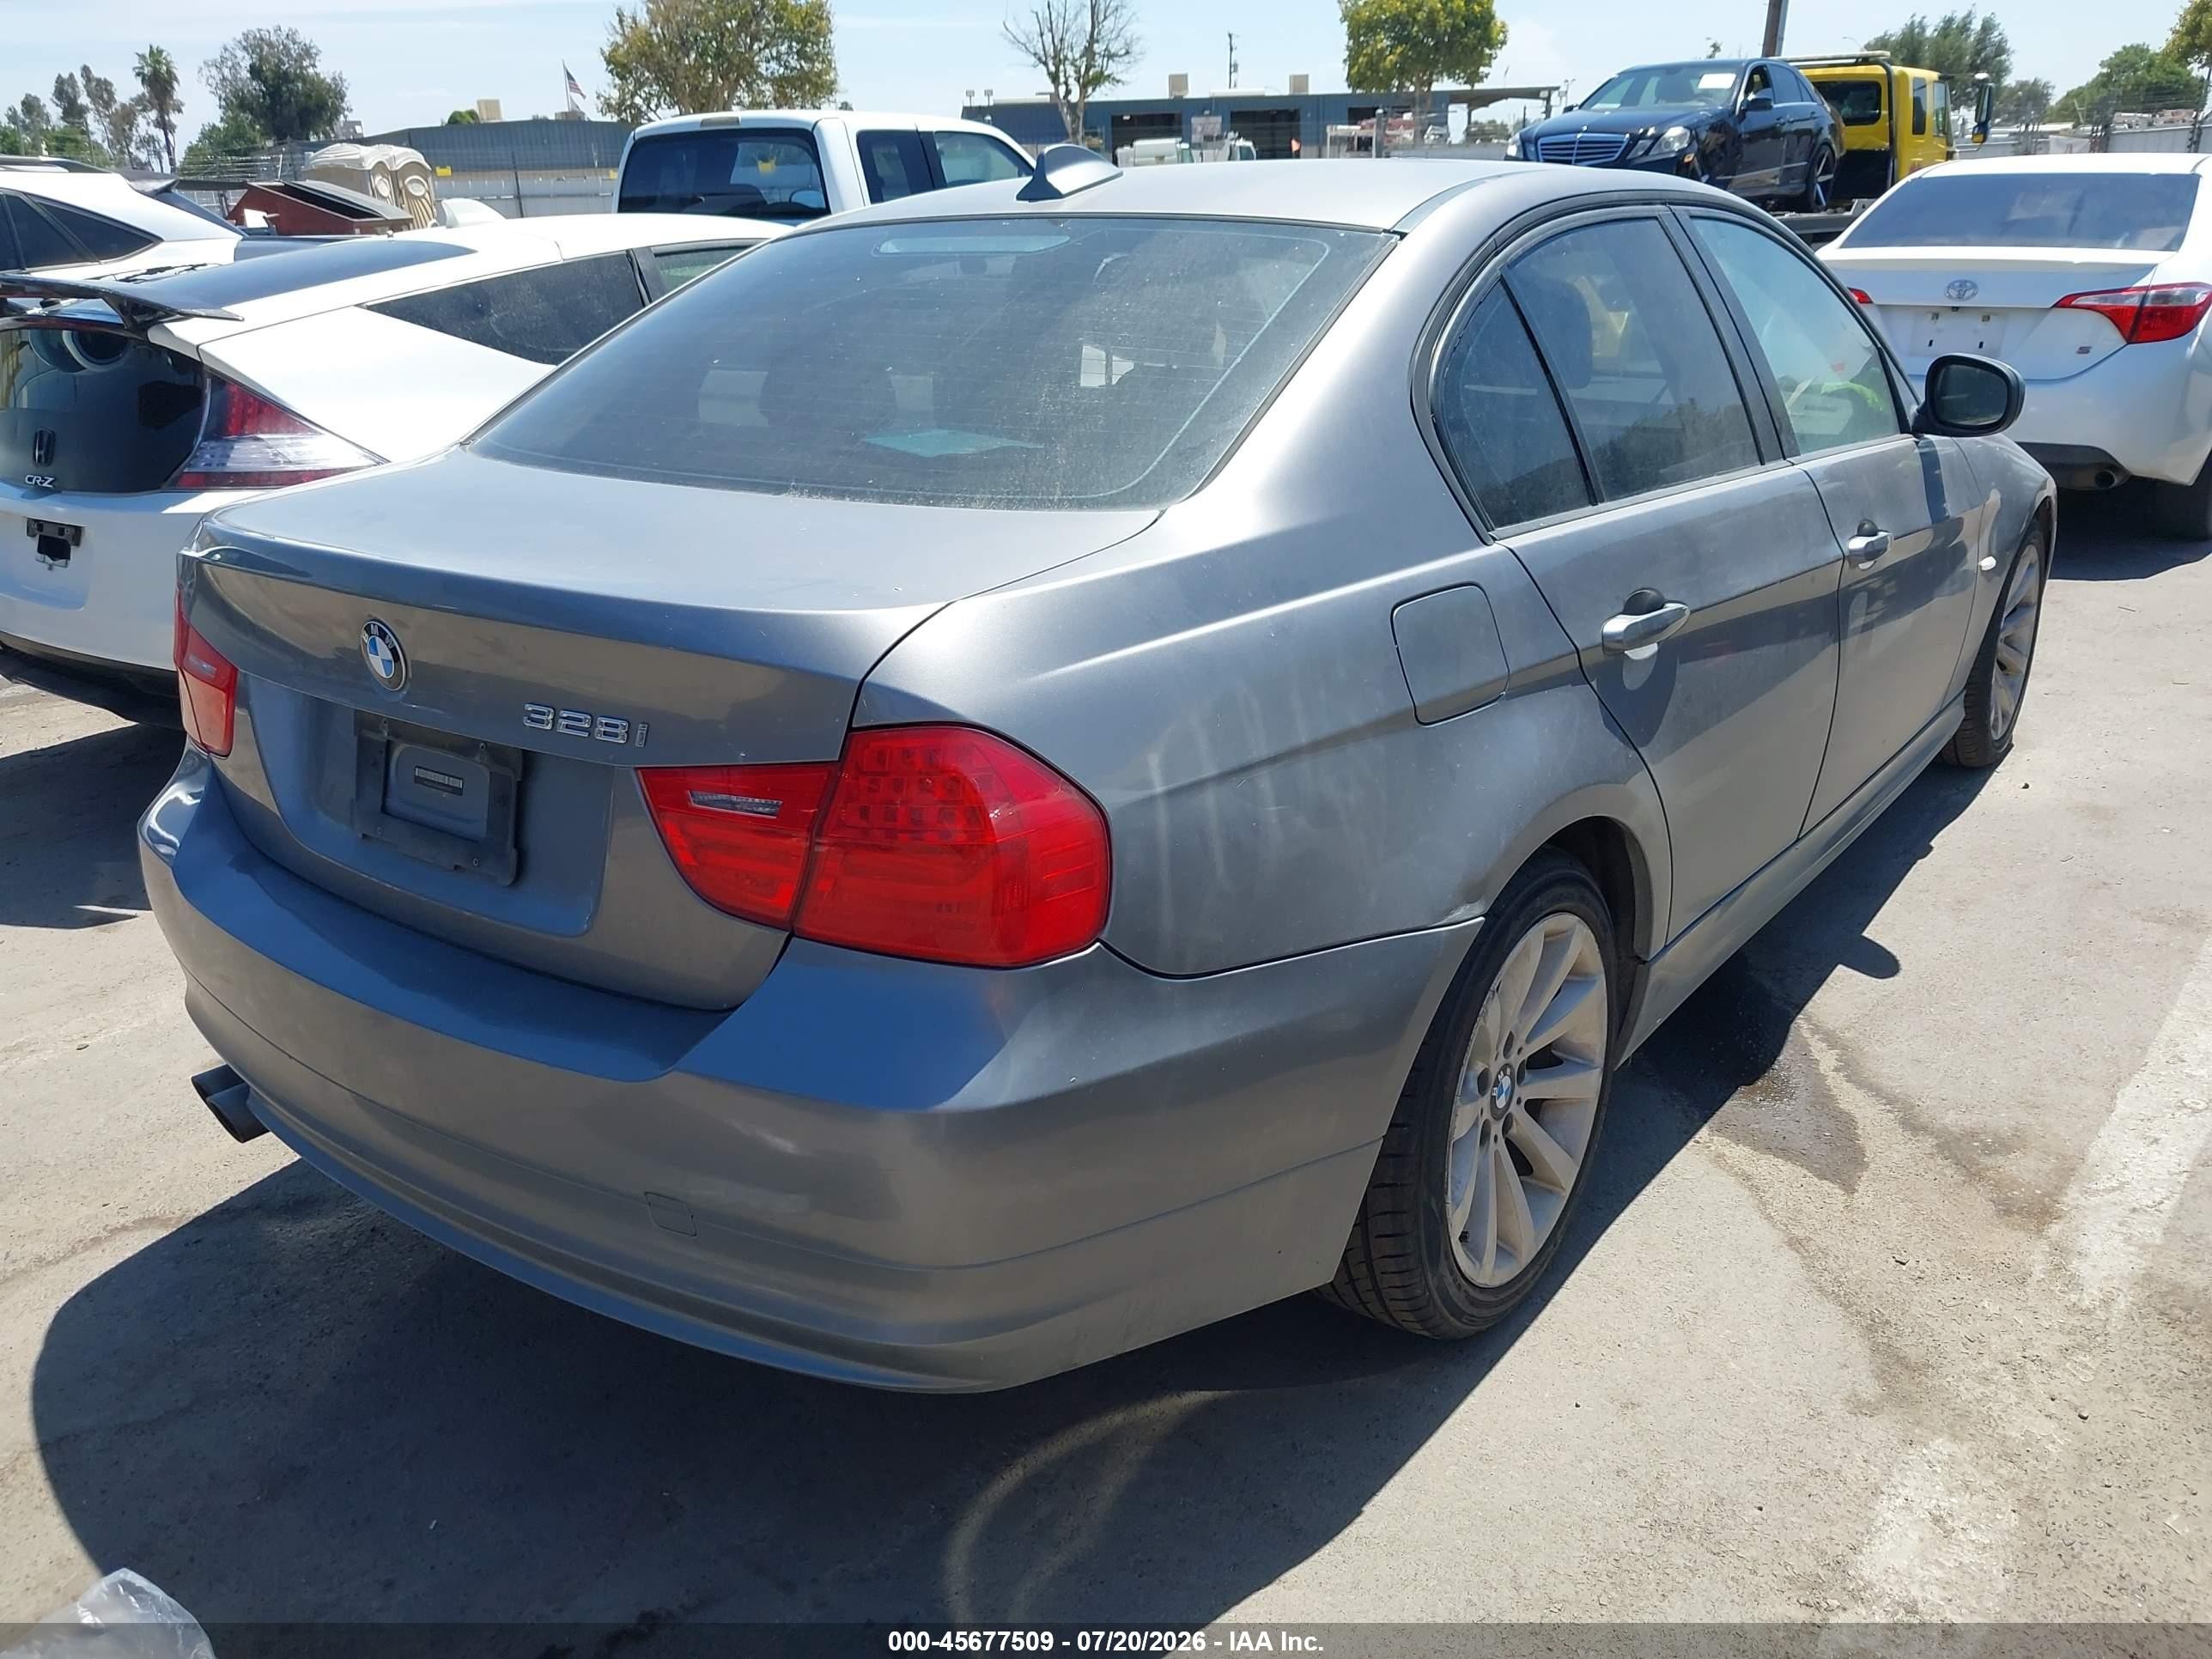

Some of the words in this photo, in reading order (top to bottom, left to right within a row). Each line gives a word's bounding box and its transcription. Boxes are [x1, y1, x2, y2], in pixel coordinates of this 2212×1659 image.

[25, 474, 55, 488] CR-Z
[362, 623, 396, 649] BMW
[522, 703, 648, 748] 328i
